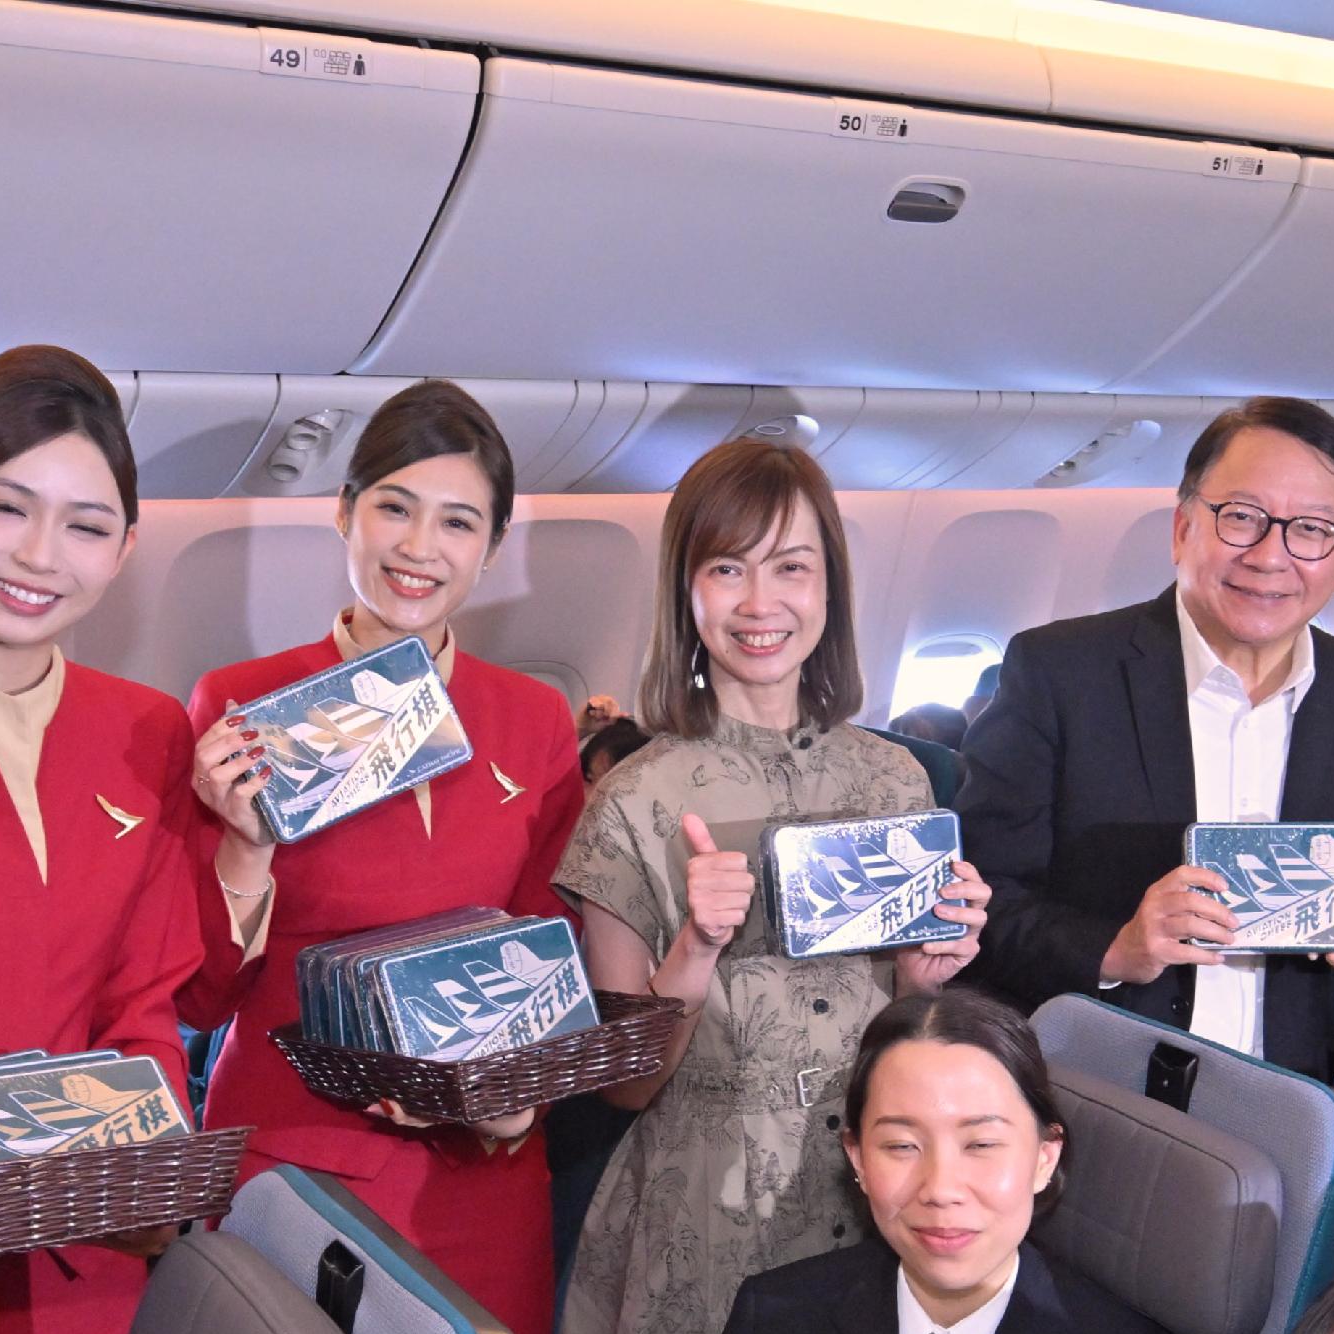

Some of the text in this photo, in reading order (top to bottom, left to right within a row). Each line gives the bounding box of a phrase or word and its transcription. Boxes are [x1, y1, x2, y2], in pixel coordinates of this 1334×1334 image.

[269, 48, 301, 68] 49
[839, 115, 862, 132] 50
[1212, 157, 1229, 171] 51
[367, 682, 441, 790] 飛行棋
